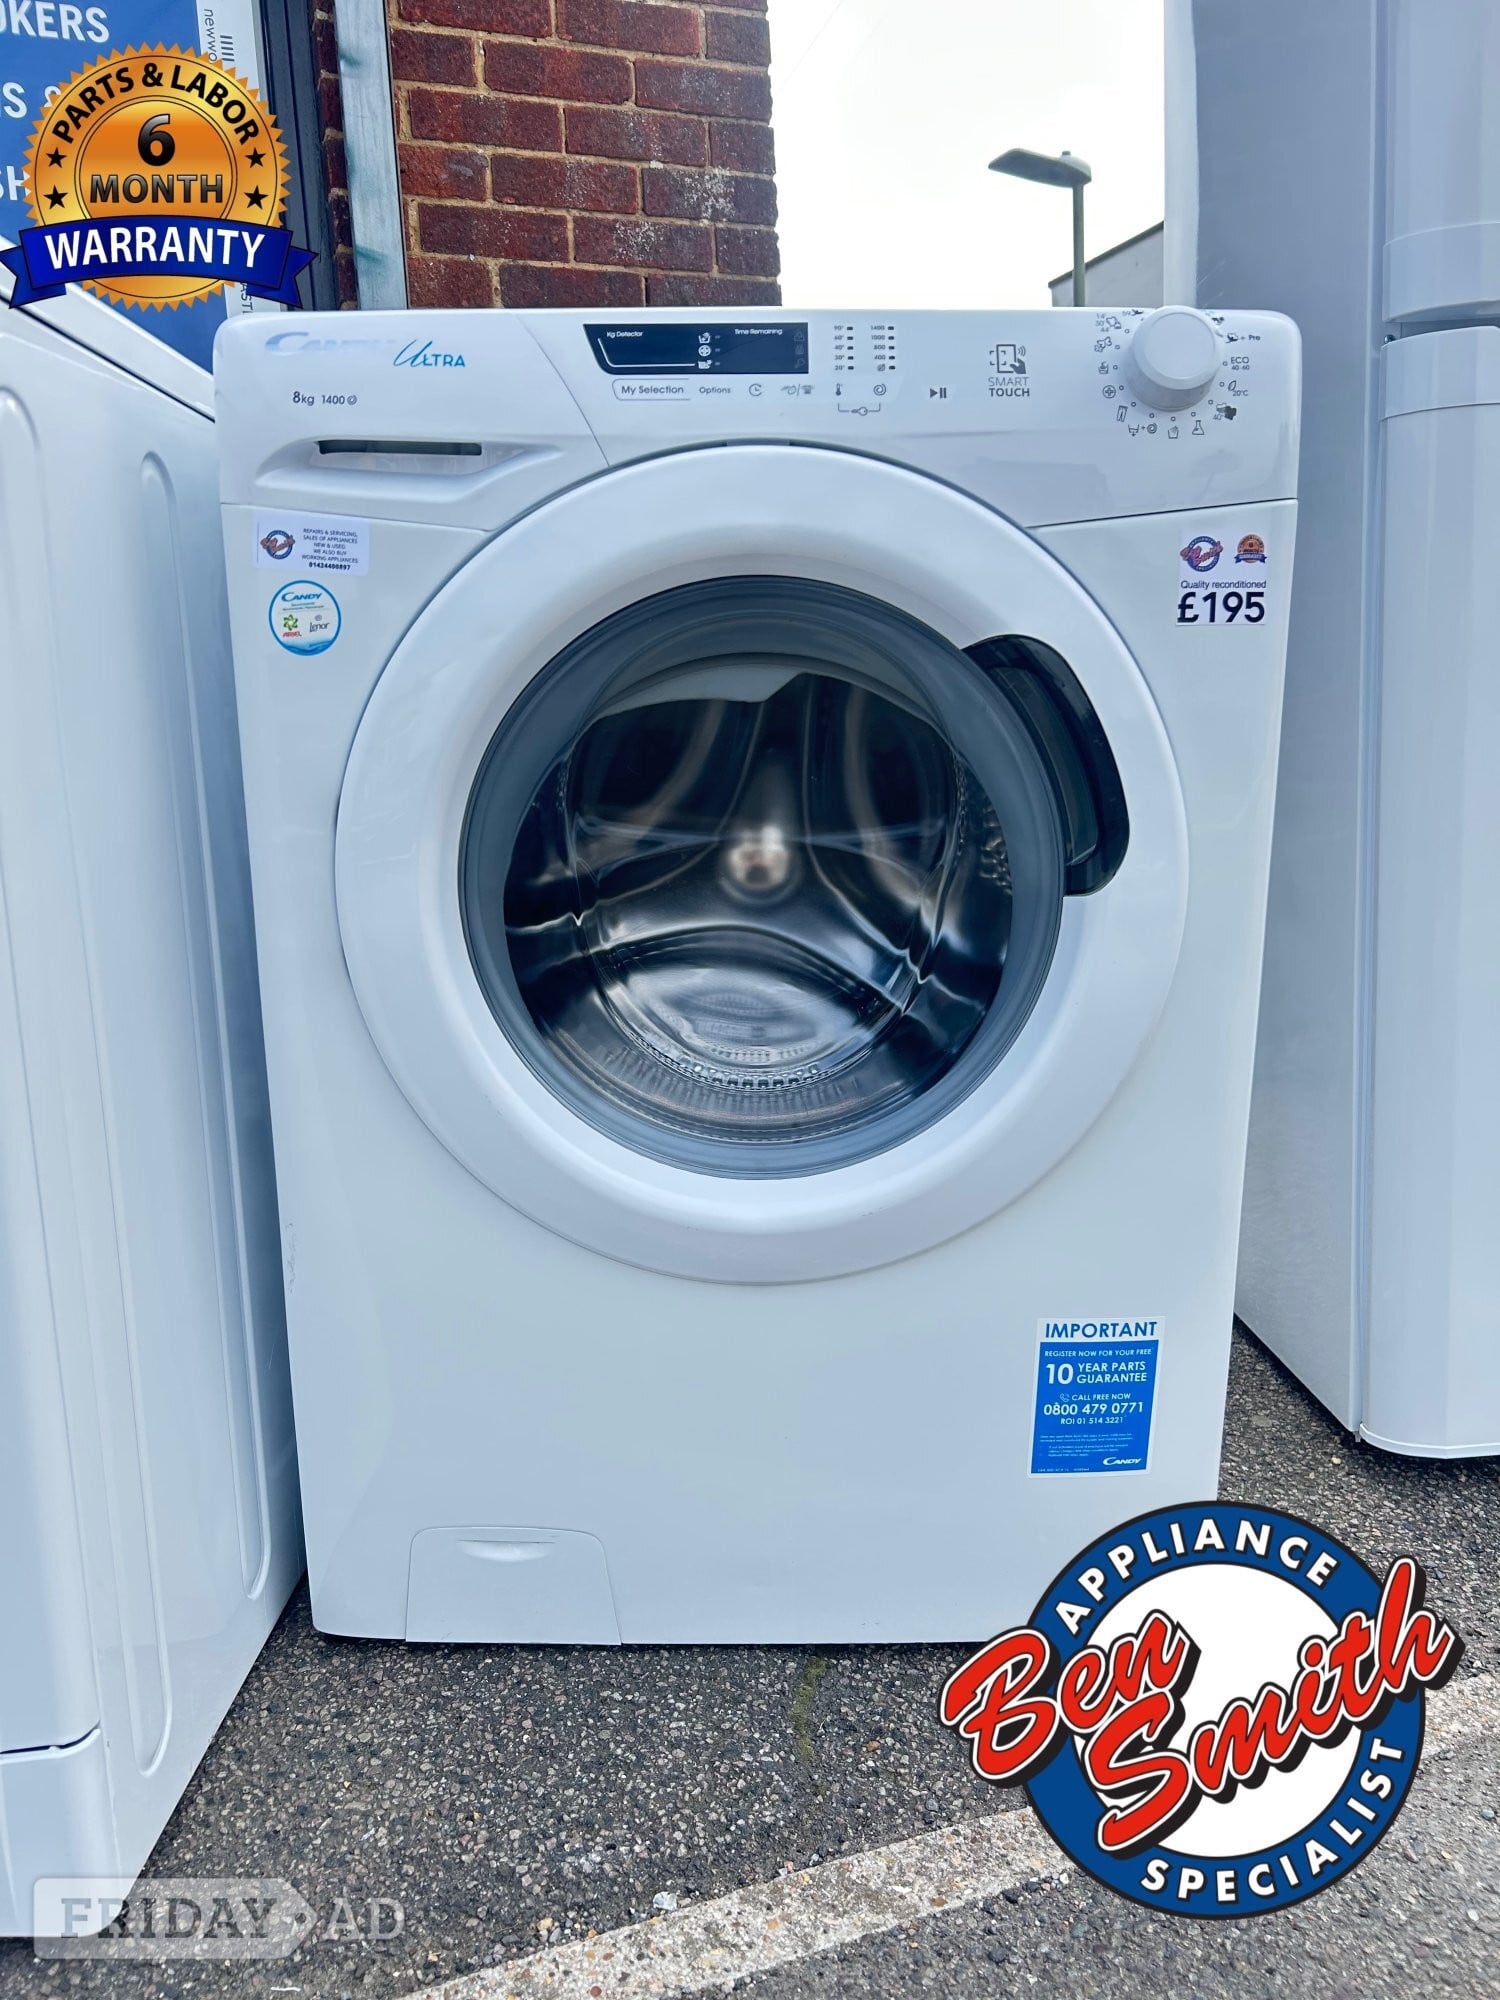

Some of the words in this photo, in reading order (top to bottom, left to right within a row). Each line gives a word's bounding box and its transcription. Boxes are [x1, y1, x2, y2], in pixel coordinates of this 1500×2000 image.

[988, 377, 1030, 387] SMART
[621, 386, 636, 395] My
[639, 385, 684, 394] Selection
[699, 386, 731, 395] Options
[989, 388, 1030, 397] TOUCH
[292, 391, 315, 406] 8kg
[321, 395, 345, 405] 1400
[1181, 580, 1210, 590] Quality
[1212, 580, 1266, 589] reconditioned
[281, 592, 322, 602] CANDY
[1177, 591, 1265, 623] £195
[309, 622, 330, 632] Lenor
[1045, 1322, 1157, 1338] IMPORTANT
[1046, 1363, 1074, 1385] 10
[1078, 1362, 1108, 1373] YEAR
[1112, 1361, 1146, 1372] PARTS
[1077, 1373, 1148, 1384] GUARANTEE
[1043, 1403, 1078, 1416] 0800
[1082, 1403, 1108, 1415] 479
[1111, 1402, 1143, 1414] 0771
[1102, 1457, 1141, 1466] CANDY
